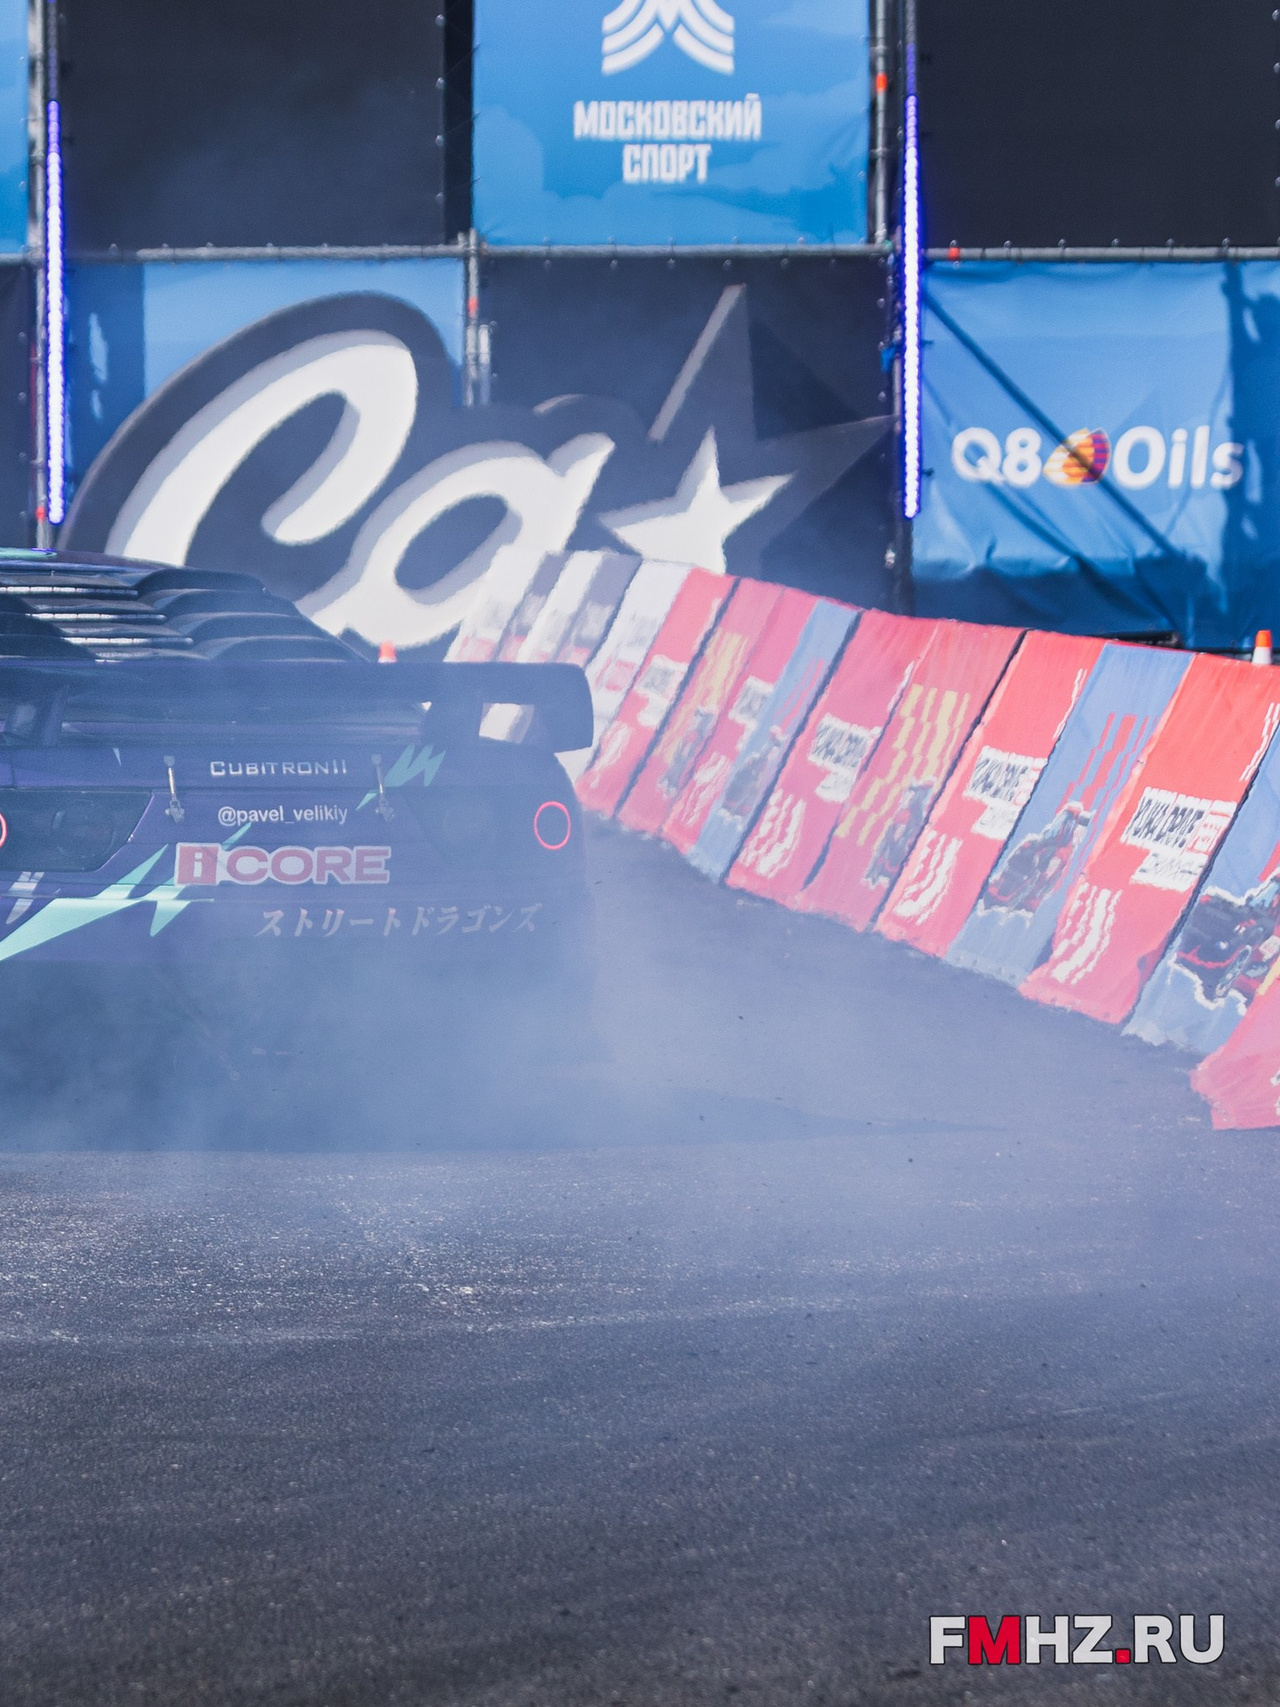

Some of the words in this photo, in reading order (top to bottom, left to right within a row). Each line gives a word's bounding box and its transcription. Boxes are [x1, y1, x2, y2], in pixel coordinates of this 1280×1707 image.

[574, 93, 762, 140] МОСКОВСКИЙ
[622, 144, 712, 183] СПОРТ
[951, 427, 1044, 488] Q8
[1112, 425, 1245, 490] Oils
[218, 804, 348, 827] @pavel_velikiy
[255, 903, 543, 938] ストリートドラゴンズ
